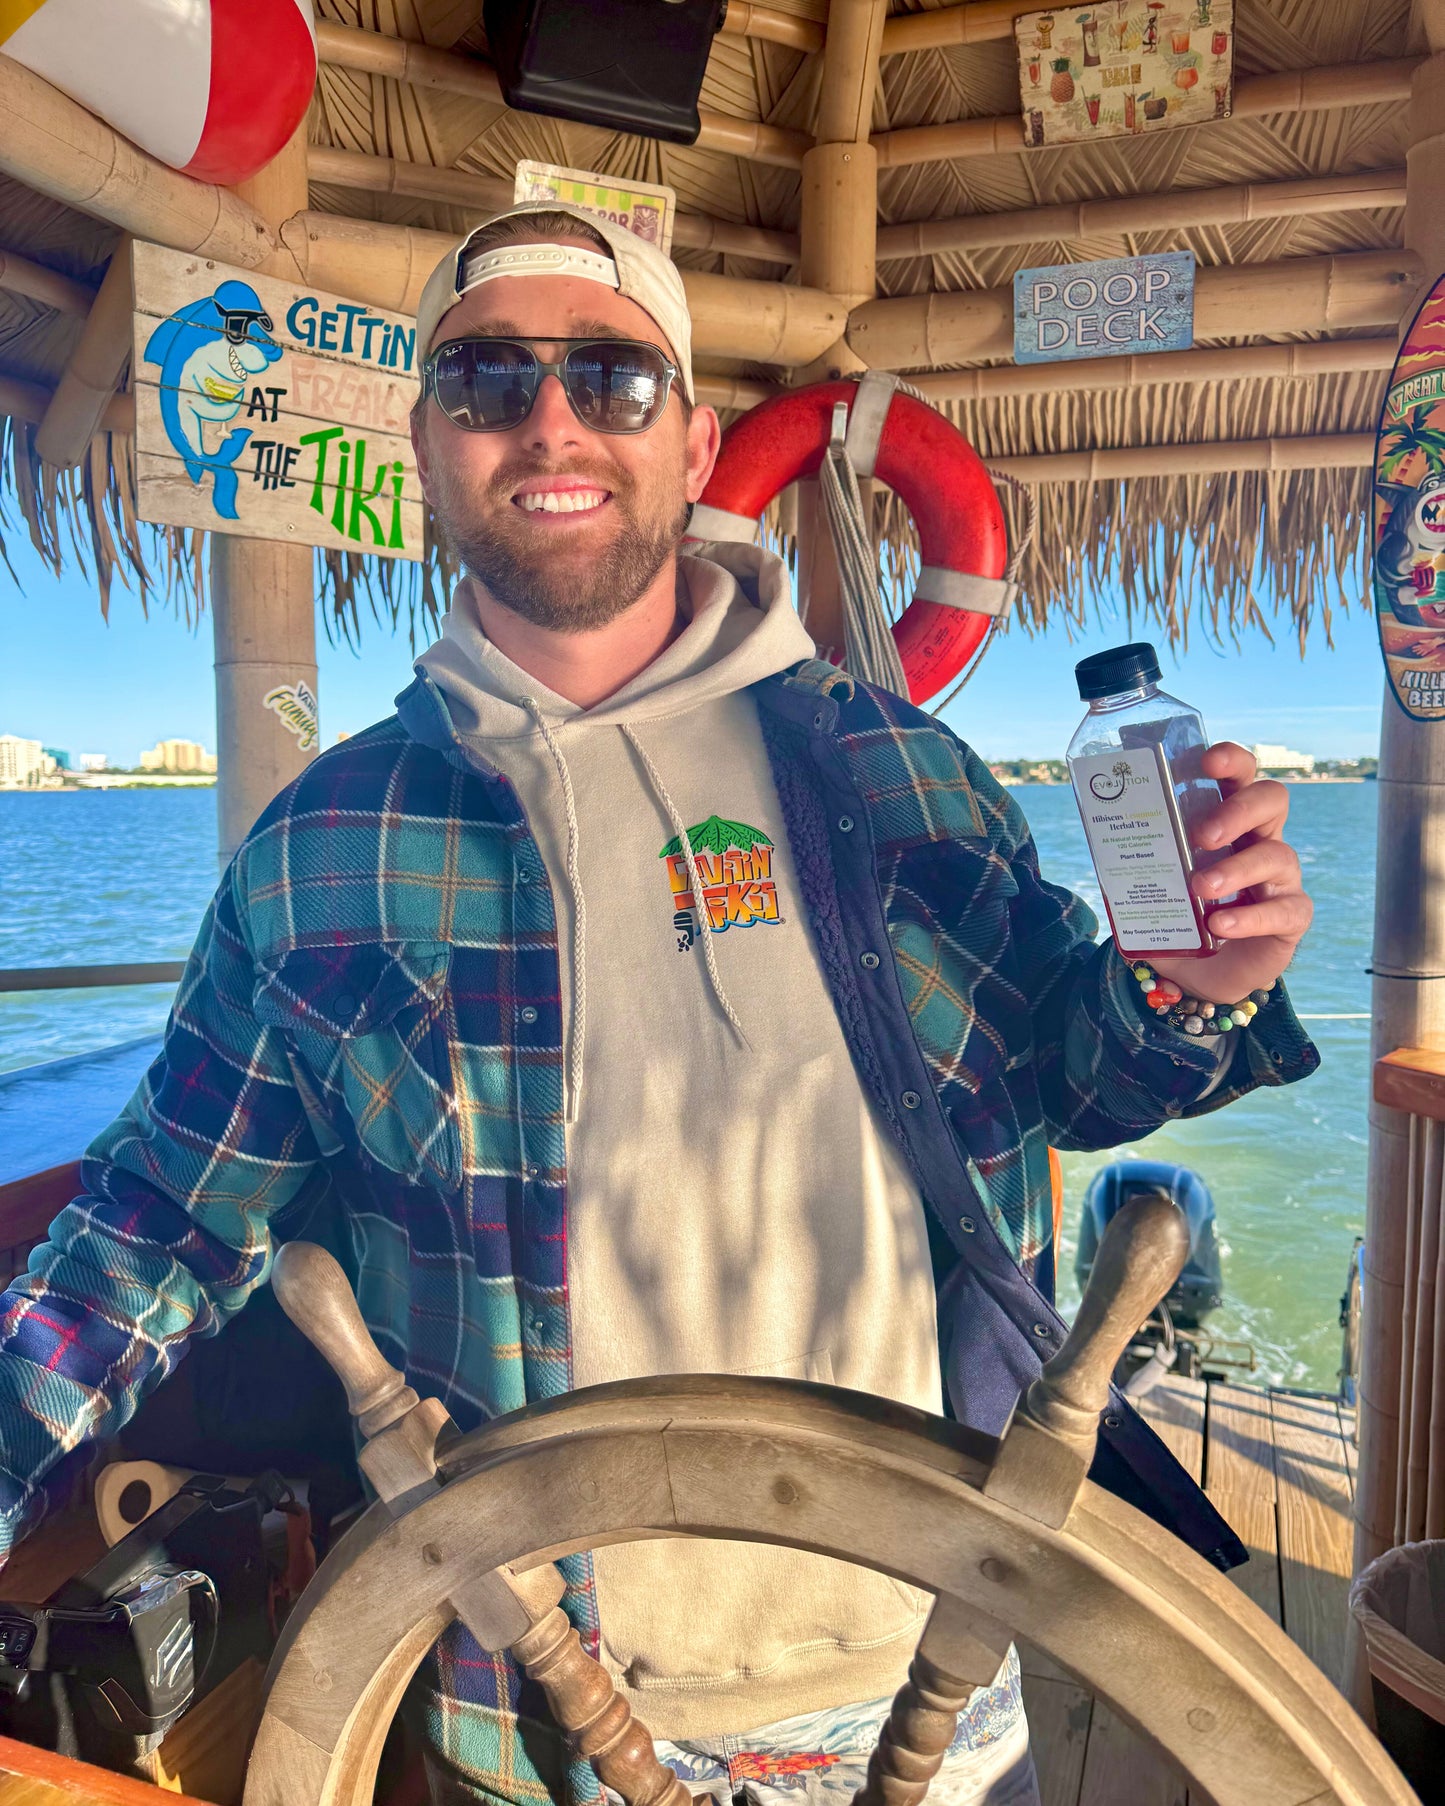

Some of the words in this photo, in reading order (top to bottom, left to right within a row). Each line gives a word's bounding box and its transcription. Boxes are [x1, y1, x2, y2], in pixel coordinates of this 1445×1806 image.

[1033, 269, 1171, 315] POOP
[1037, 307, 1168, 350] DECK
[247, 387, 287, 422] AT
[250, 441, 301, 490] THE
[1400, 670, 1445, 690] KILL
[1092, 814, 1123, 823] Hibiscus
[1110, 821, 1134, 831] Herbal
